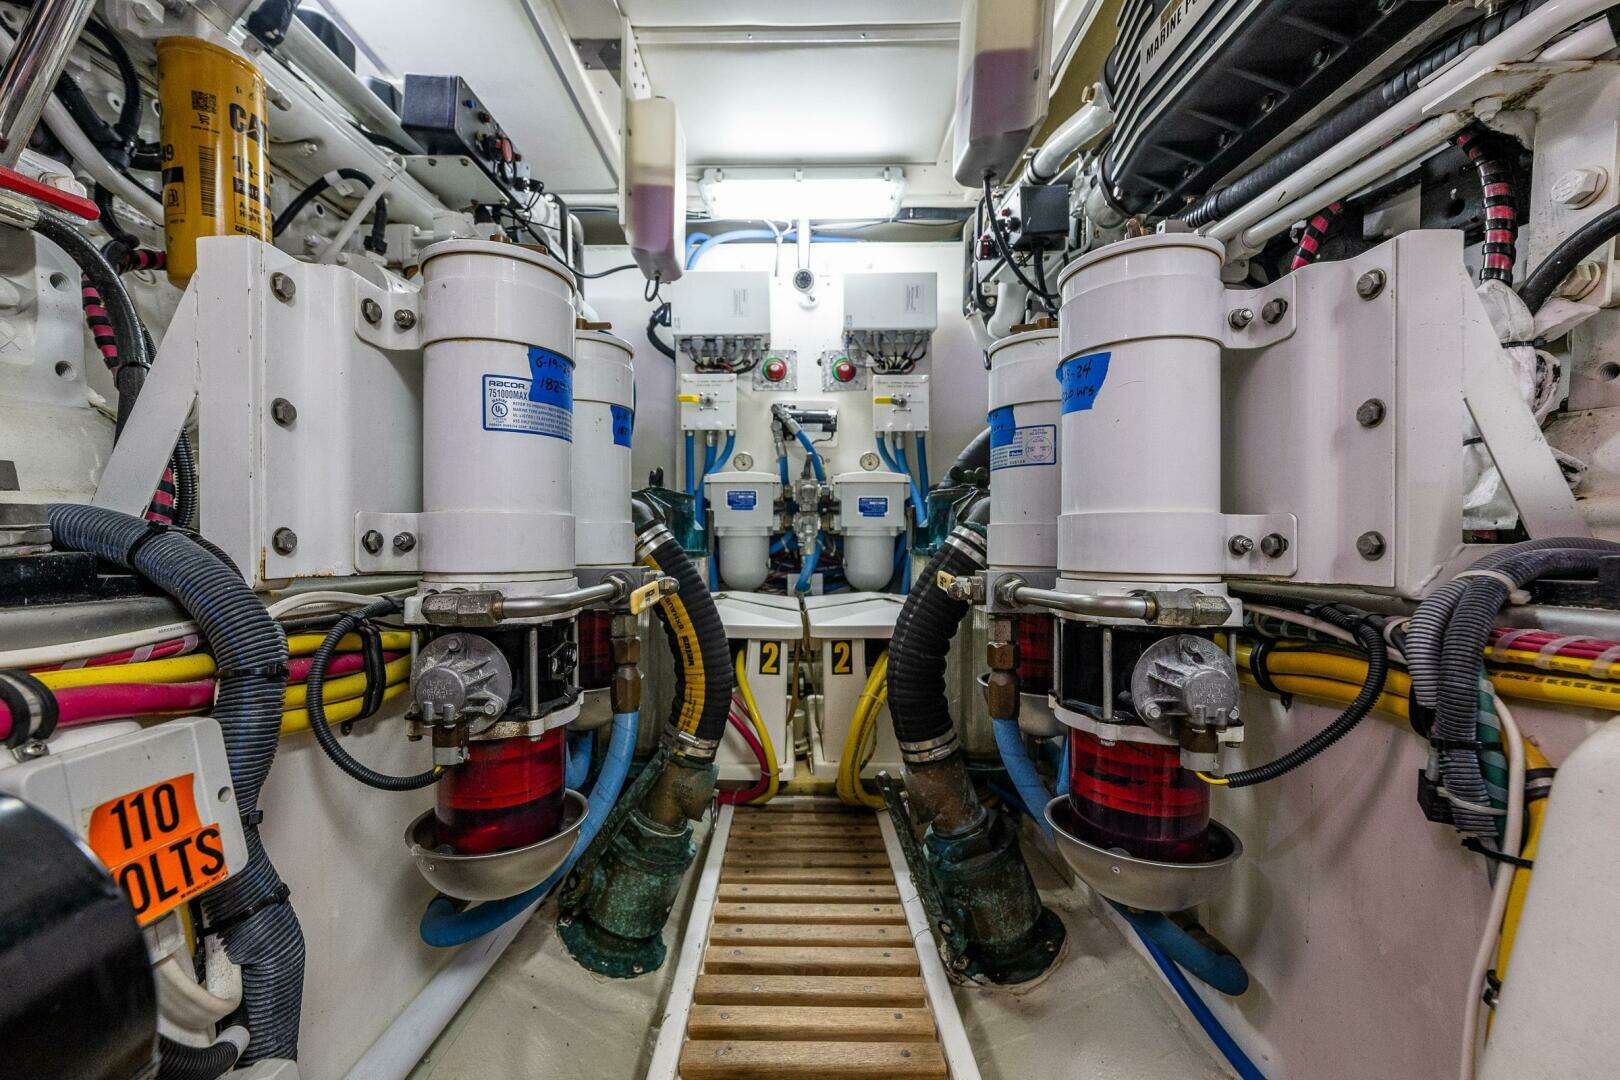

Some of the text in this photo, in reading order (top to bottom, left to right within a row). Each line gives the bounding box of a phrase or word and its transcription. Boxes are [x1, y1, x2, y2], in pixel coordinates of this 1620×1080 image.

[1146, 7, 1182, 64] MARINE
[489, 381, 525, 390] RACOR
[489, 389, 528, 401] 751000MAX
[495, 405, 504, 415] UL
[762, 642, 778, 673] 2
[834, 641, 850, 673] 2
[110, 783, 180, 850] 110
[119, 828, 225, 914] OLTS
